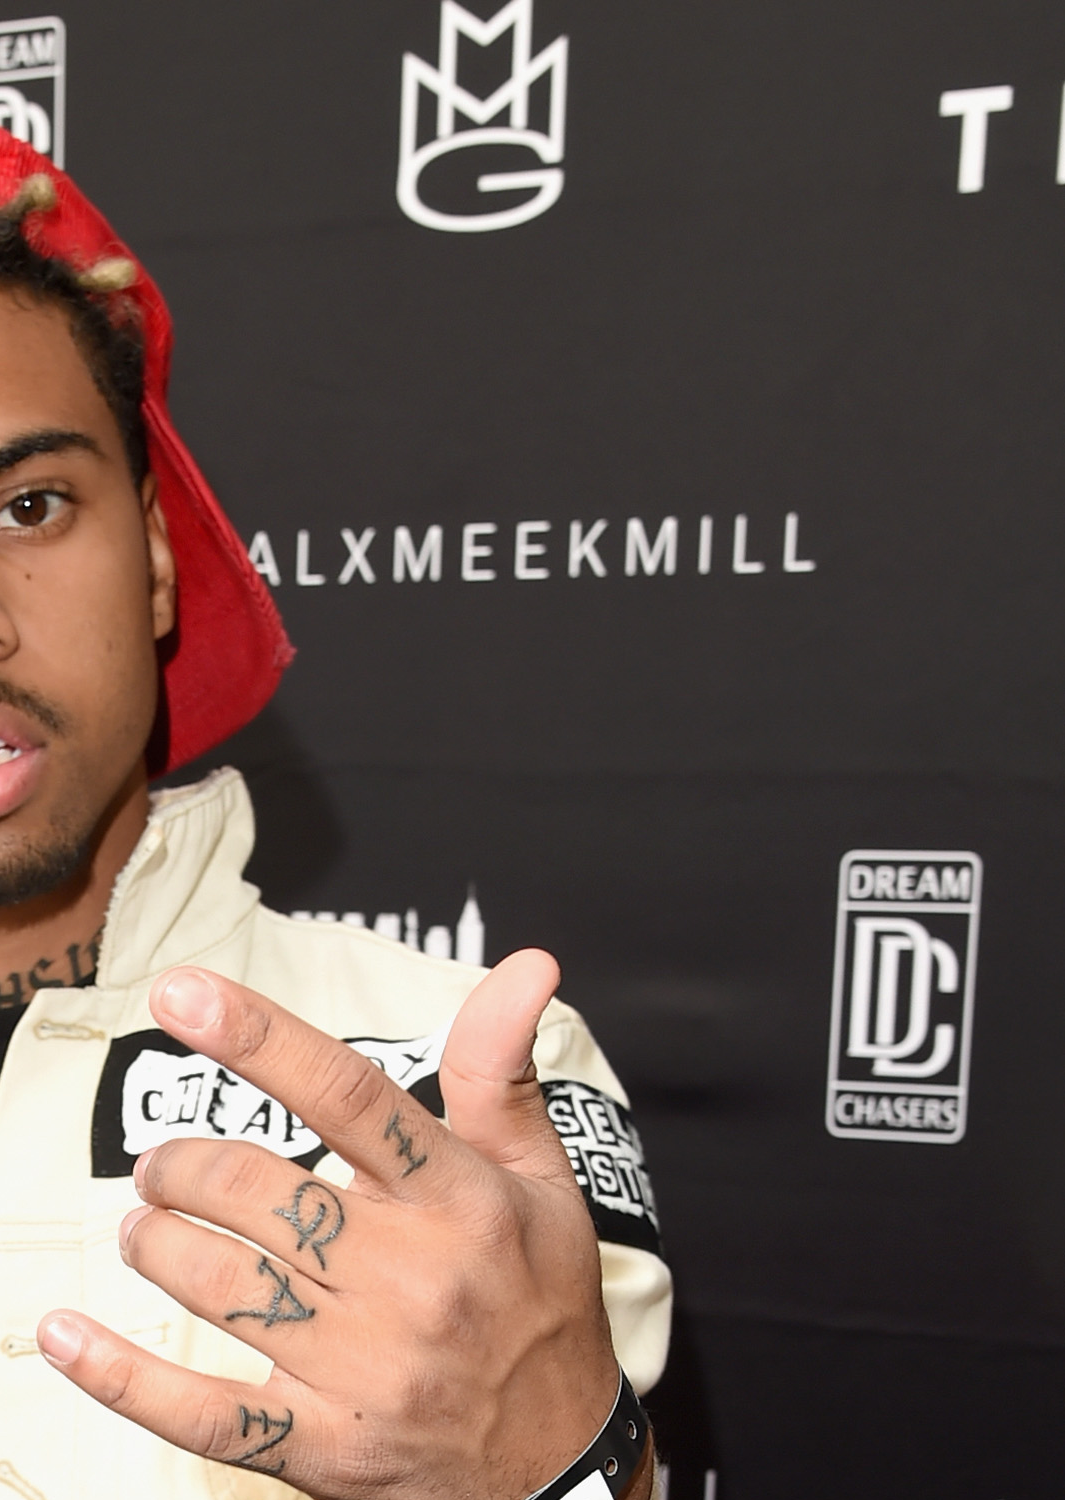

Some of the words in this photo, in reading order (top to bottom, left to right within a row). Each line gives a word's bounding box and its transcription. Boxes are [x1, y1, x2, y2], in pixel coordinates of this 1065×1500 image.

[247, 512, 815, 587] ALXMEEKMILL
[848, 864, 971, 900] DREAM
[835, 1094, 958, 1130] CHASERS
